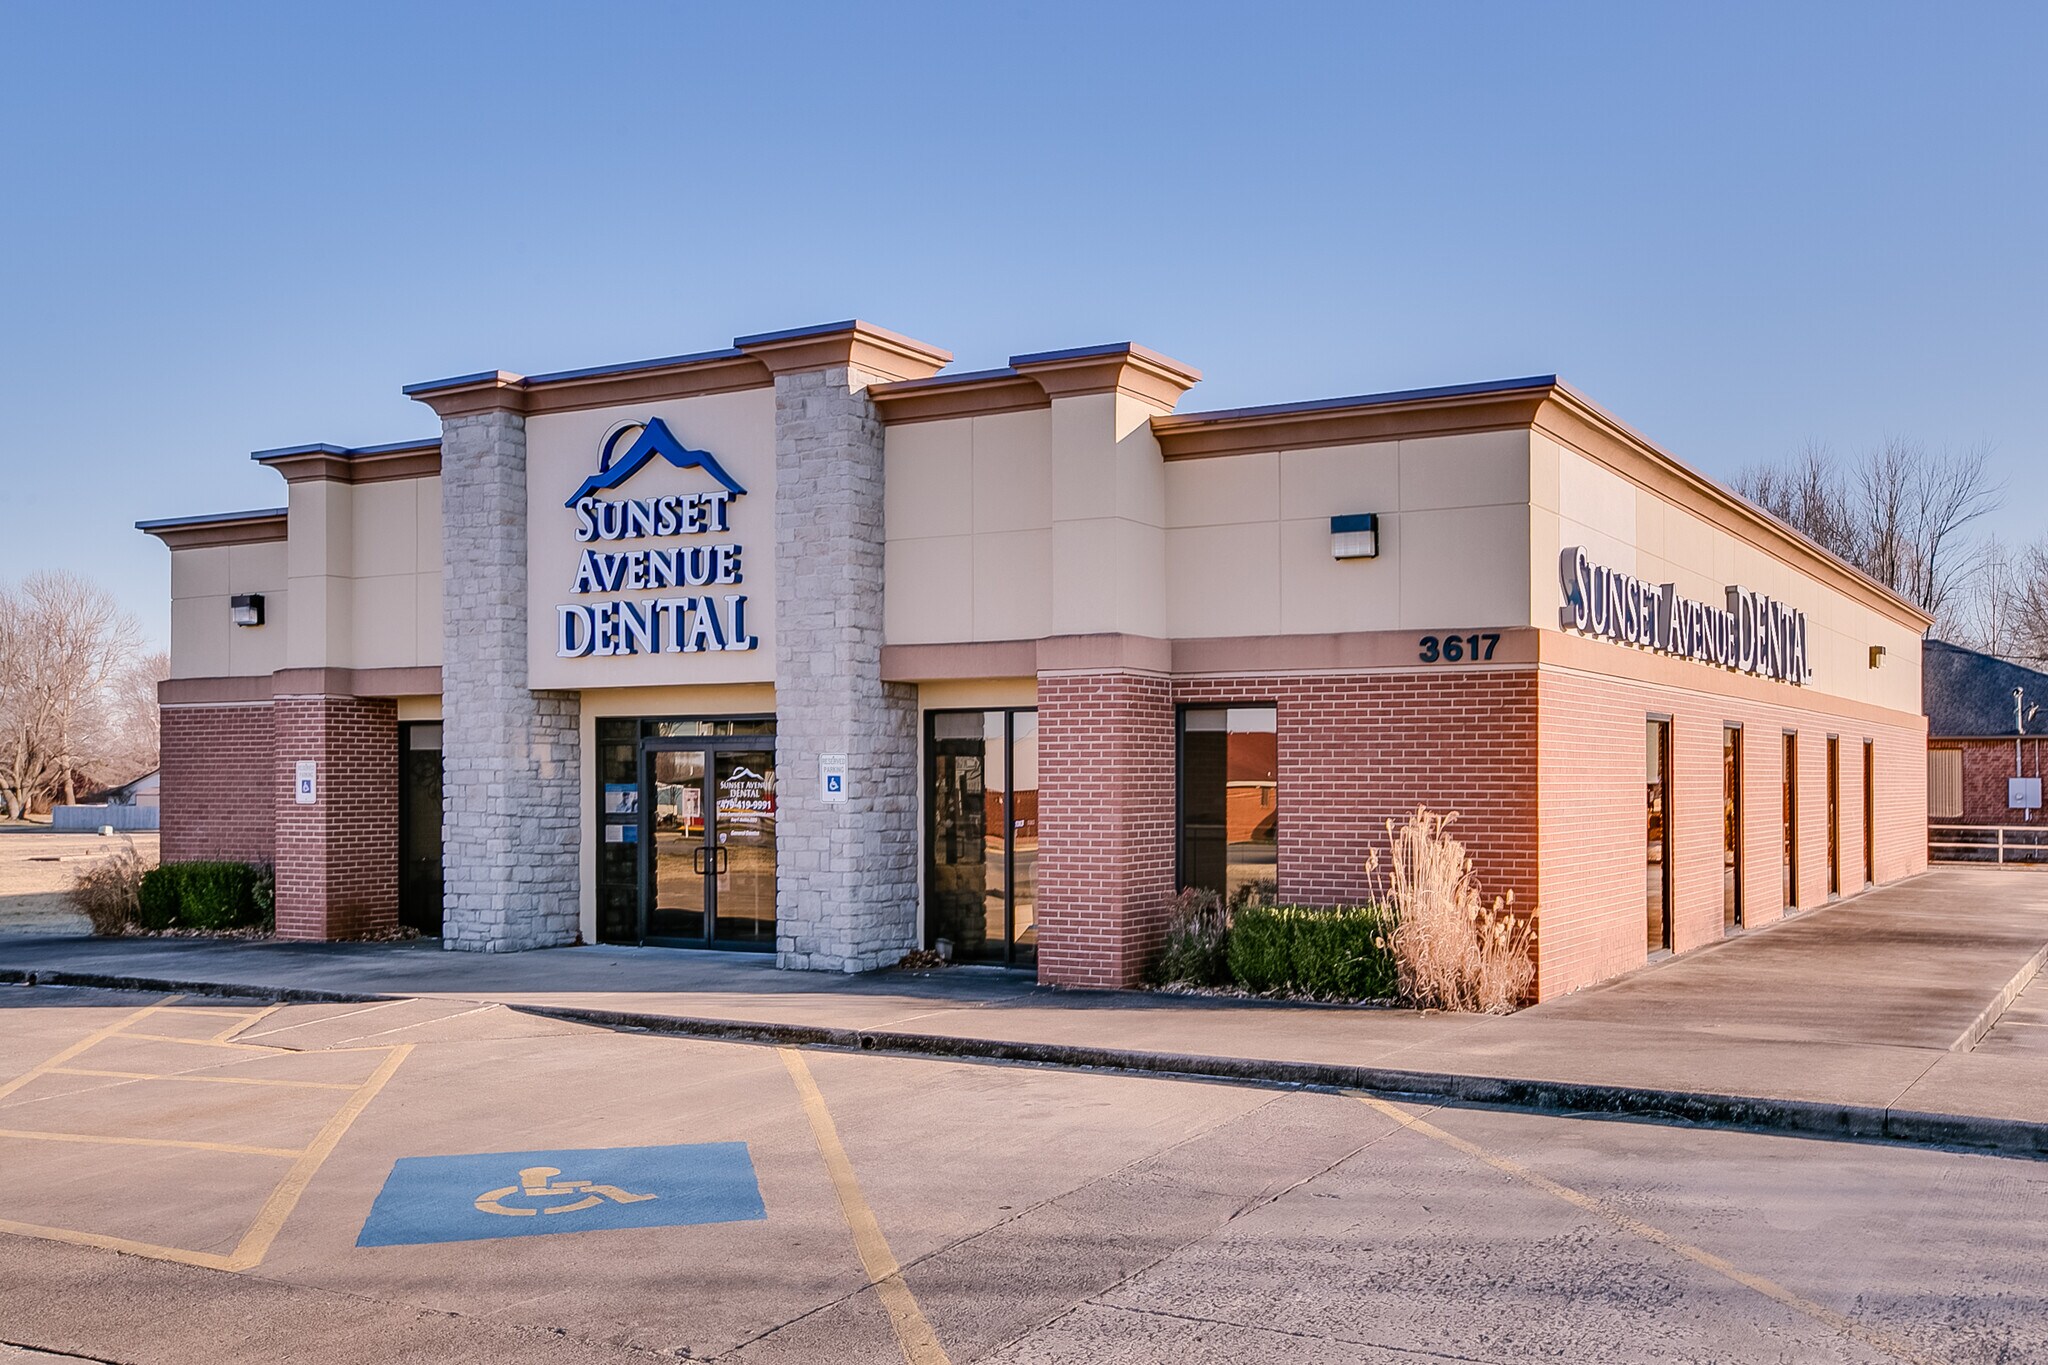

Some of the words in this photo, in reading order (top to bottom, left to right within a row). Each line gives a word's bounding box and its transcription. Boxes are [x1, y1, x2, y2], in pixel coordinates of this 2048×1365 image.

[575, 491, 733, 542] SUNSET
[570, 544, 740, 593] AVENUE
[556, 595, 757, 658] DENTAL
[1561, 546, 1664, 649] SUNSET
[1666, 583, 1736, 667] AVENUE
[1728, 585, 1813, 686] DENTAL
[1419, 633, 1501, 663] 3617
[719, 800, 771, 810] 479-419-9991
[720, 781, 744, 790] SUNSET
[730, 789, 760, 798] DENTAL
